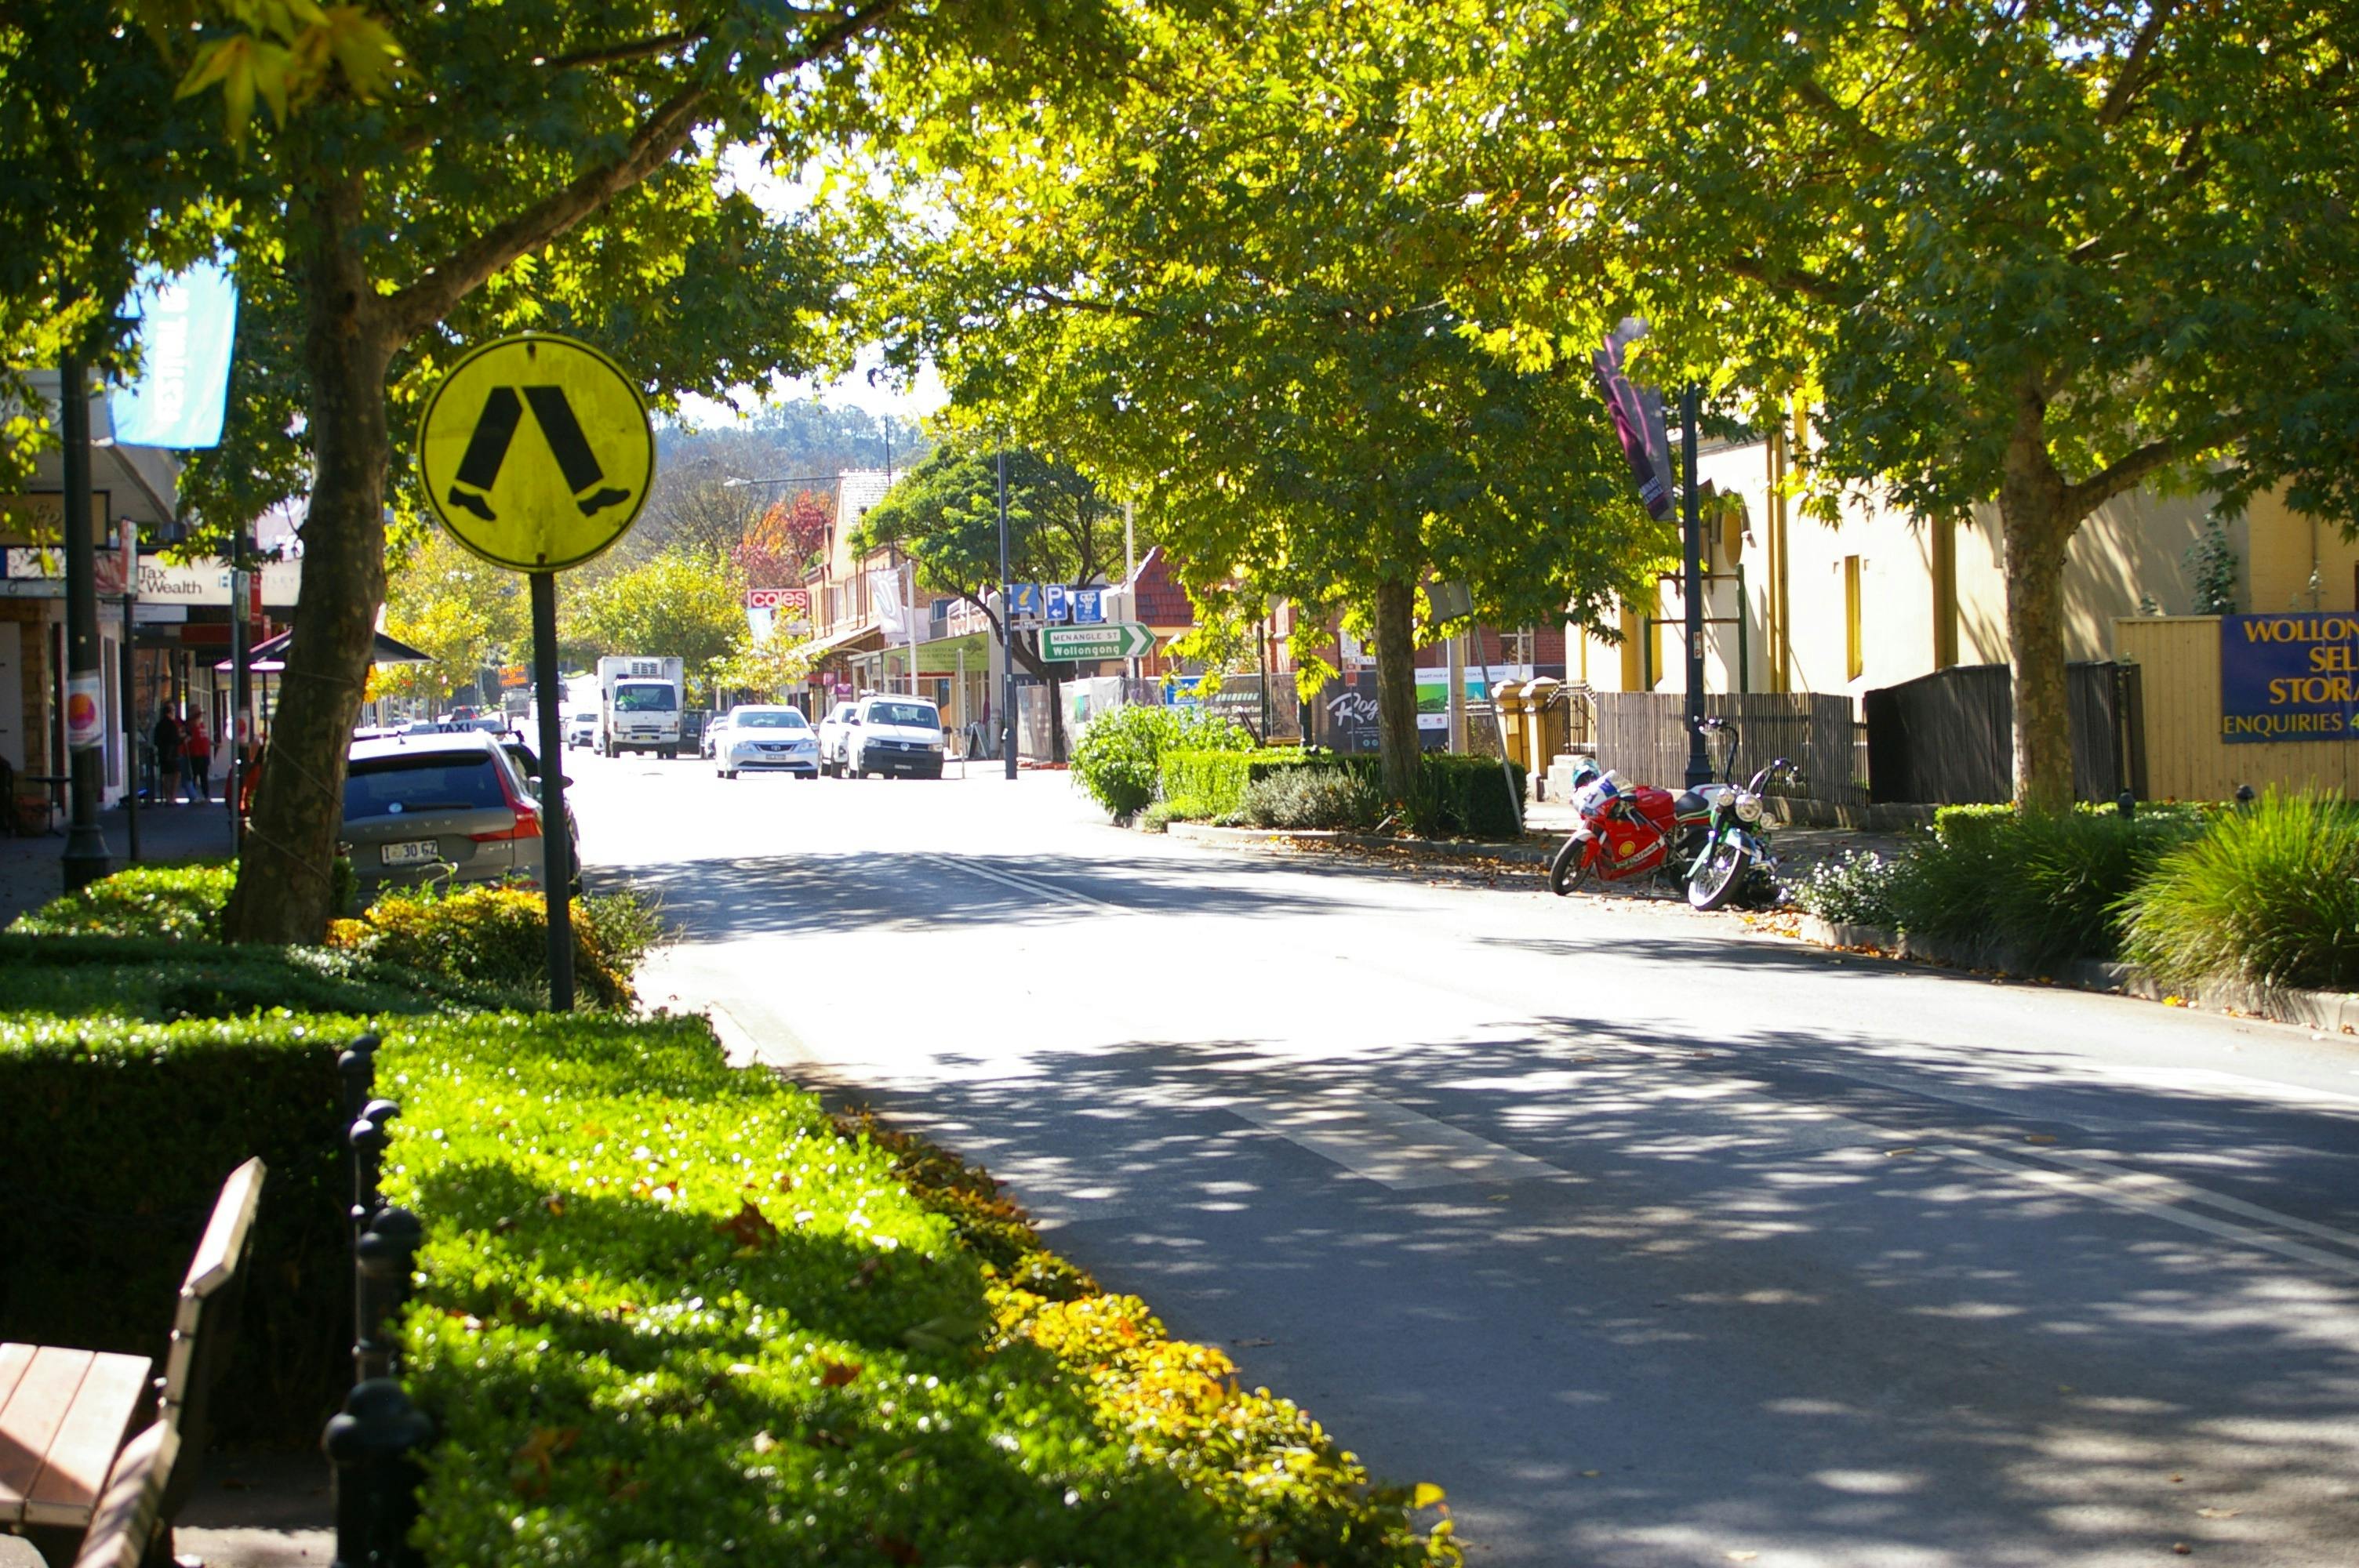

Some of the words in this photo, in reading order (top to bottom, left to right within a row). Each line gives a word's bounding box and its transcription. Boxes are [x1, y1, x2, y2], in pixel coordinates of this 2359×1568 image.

[140, 565, 166, 579] Tax
[147, 580, 202, 594] Wealth
[752, 590, 806, 607] coles
[1048, 587, 1063, 606] P
[1053, 633, 1102, 641] MENANGLE
[1053, 644, 1120, 656] Wollongong
[2269, 677, 2359, 704] STOR
[437, 721, 471, 733] TAXI
[2223, 713, 2343, 737] ENQUIRIES
